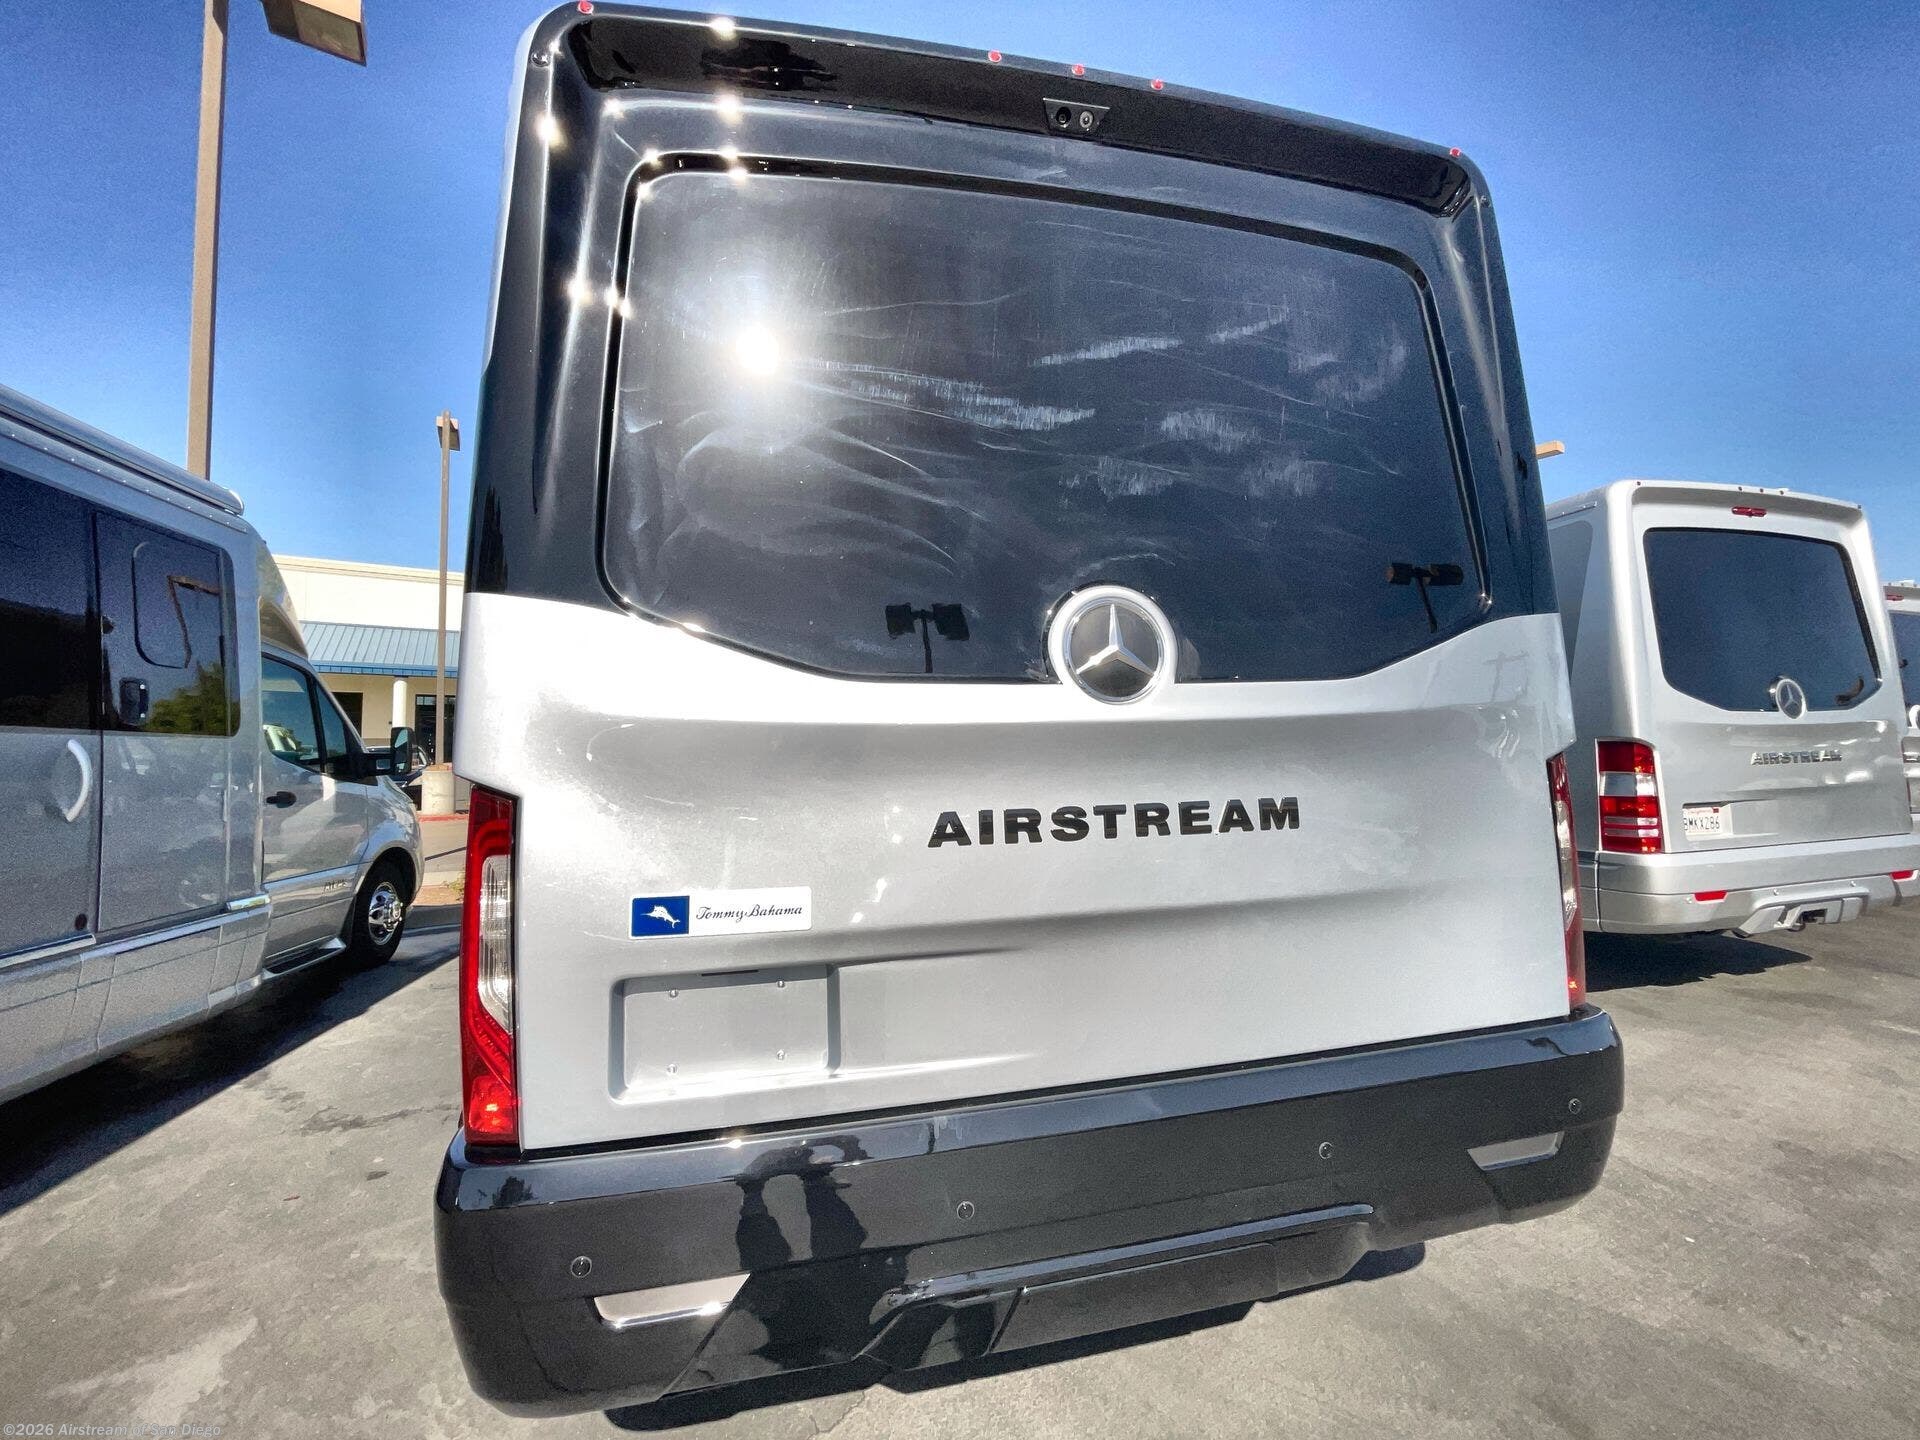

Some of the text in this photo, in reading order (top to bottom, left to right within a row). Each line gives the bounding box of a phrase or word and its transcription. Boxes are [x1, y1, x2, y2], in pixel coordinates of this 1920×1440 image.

[1751, 750, 1842, 765] AIRSTREAM
[927, 796, 1300, 848] AIRSTREAM
[696, 904, 802, 923] Tommy Bahama
